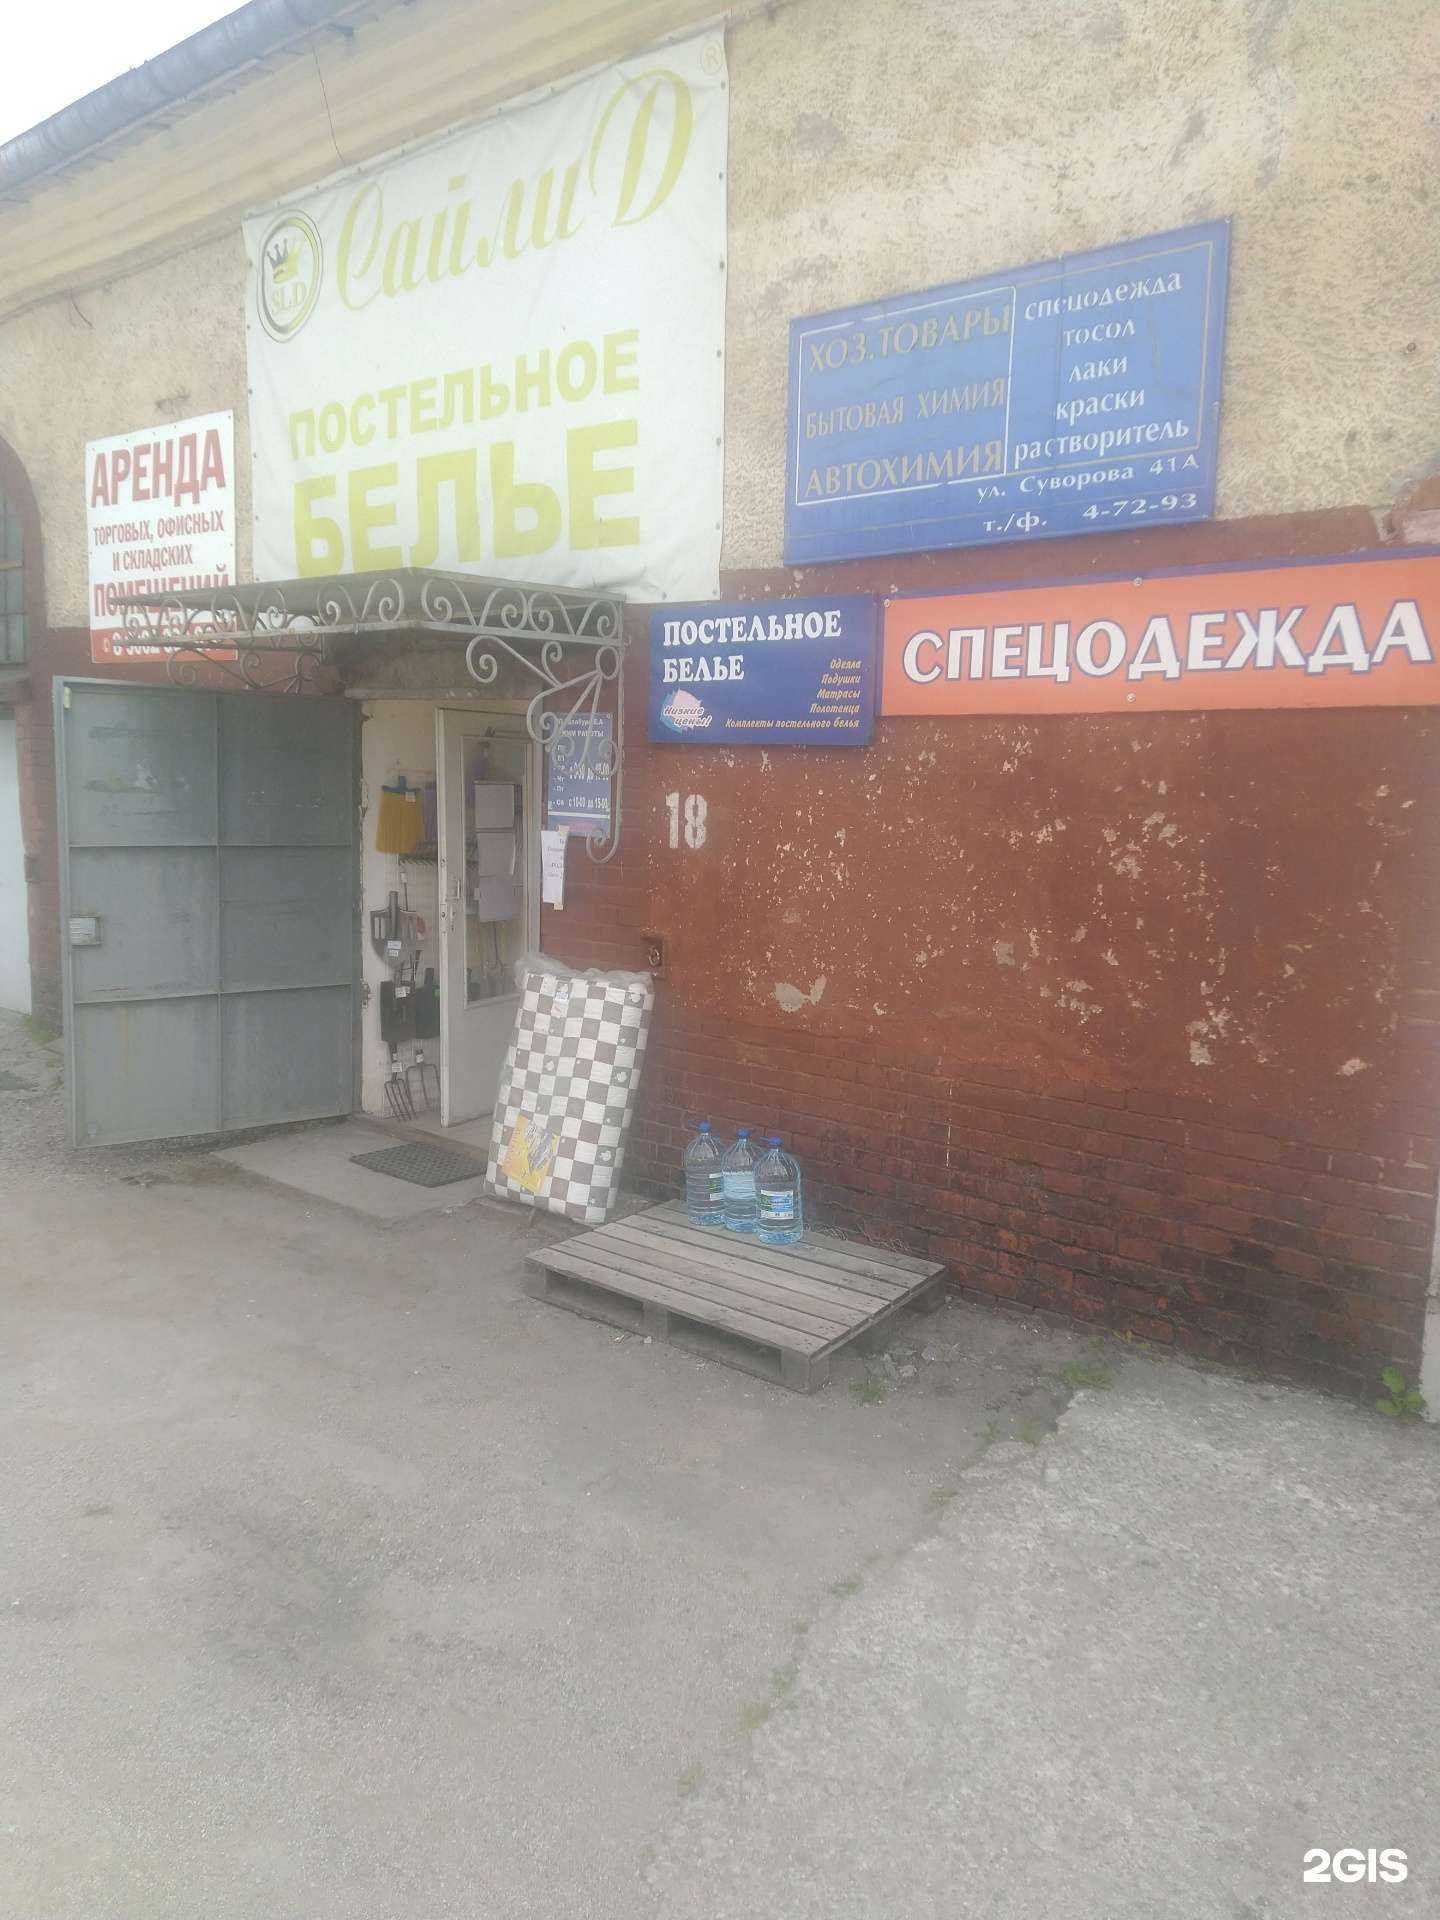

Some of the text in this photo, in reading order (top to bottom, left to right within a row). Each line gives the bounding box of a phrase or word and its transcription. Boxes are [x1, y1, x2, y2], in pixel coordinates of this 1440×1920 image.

[1024, 271, 1182, 322] спецодежда
[808, 304, 1010, 374] ХОЗ.ТОВАРЫ
[1062, 319, 1137, 347] тосол
[1067, 356, 1129, 384] лаки
[288, 328, 640, 460] ПОСТЕЛЬНОЕ
[805, 377, 1006, 440] БЫТОВАЯ ХИМИЯ
[1055, 389, 1146, 430] краски
[1013, 419, 1190, 469] растворитель
[91, 428, 227, 508] АРЕНДА
[804, 440, 1002, 499] АВТОХИМИЯ
[976, 485, 1006, 503] ул.
[1019, 466, 1134, 497] Суворова
[292, 418, 641, 579] БЕЛЬЕ
[1082, 492, 1198, 521] 4-72-93
[93, 510, 225, 546] ТОРГОВЫХ, ОФИСНЫХ
[112, 543, 194, 573] И СКЛАДСКИХ
[663, 609, 842, 647] ПОСТЕЛЬНОЕ
[902, 598, 1433, 684] СПЕЦОДЕЖДА
[662, 654, 745, 683] БЕЛЬЕ
[820, 673, 861, 686] Подушки
[829, 657, 861, 670] Одеяла
[809, 703, 860, 716] Полотенца
[816, 688, 861, 701] Матрасы
[724, 716, 860, 729] Комплекты постельного белья
[665, 791, 708, 849] 18
